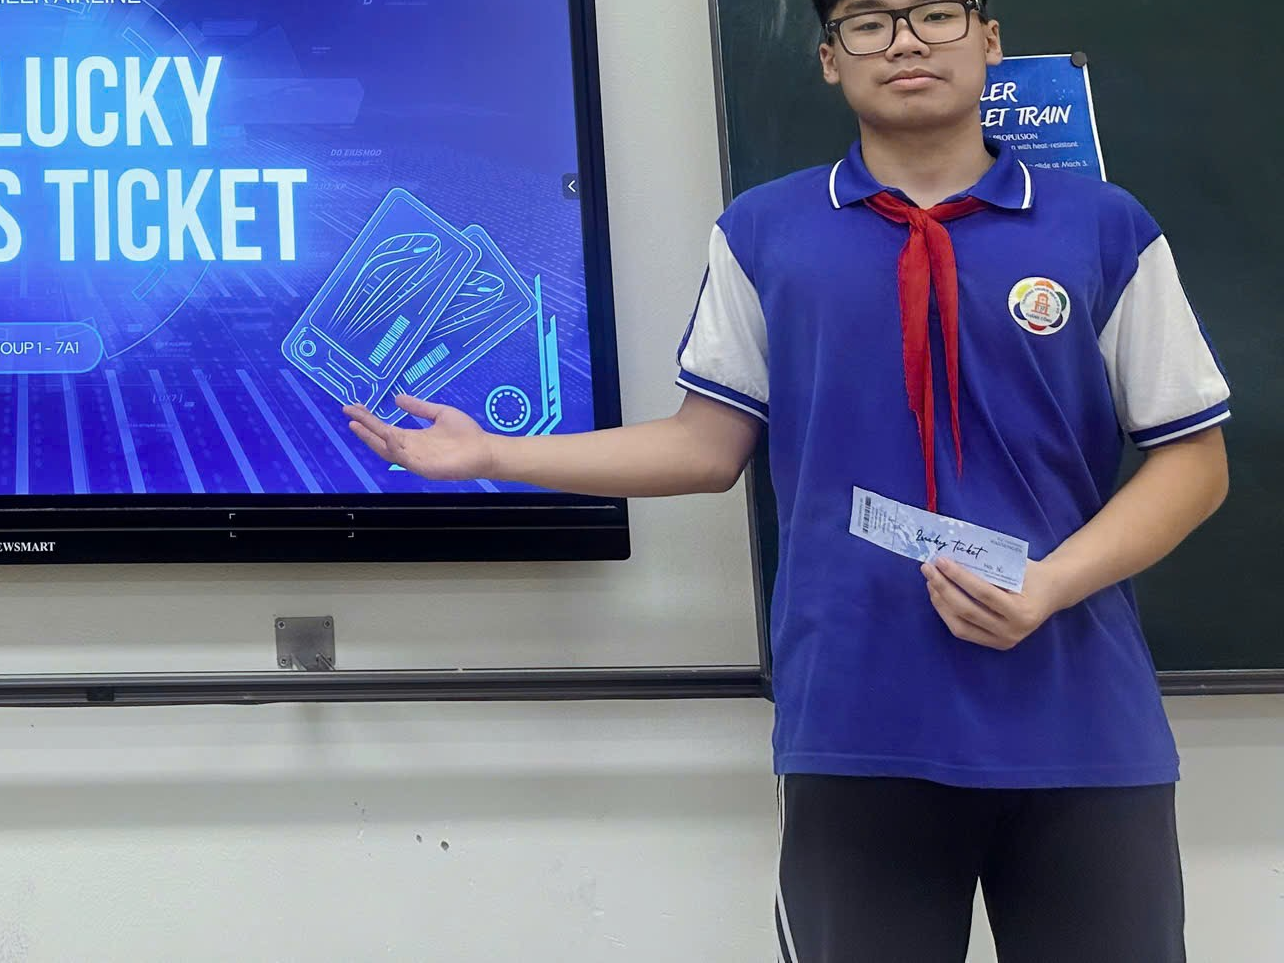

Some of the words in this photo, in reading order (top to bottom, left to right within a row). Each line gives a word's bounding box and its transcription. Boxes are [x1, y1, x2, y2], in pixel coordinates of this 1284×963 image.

[1015, 105, 1072, 127] TRAIN
[44, 167, 308, 262] TICKET
[36, 340, 43, 355] 1
[54, 339, 81, 355] 7A1
